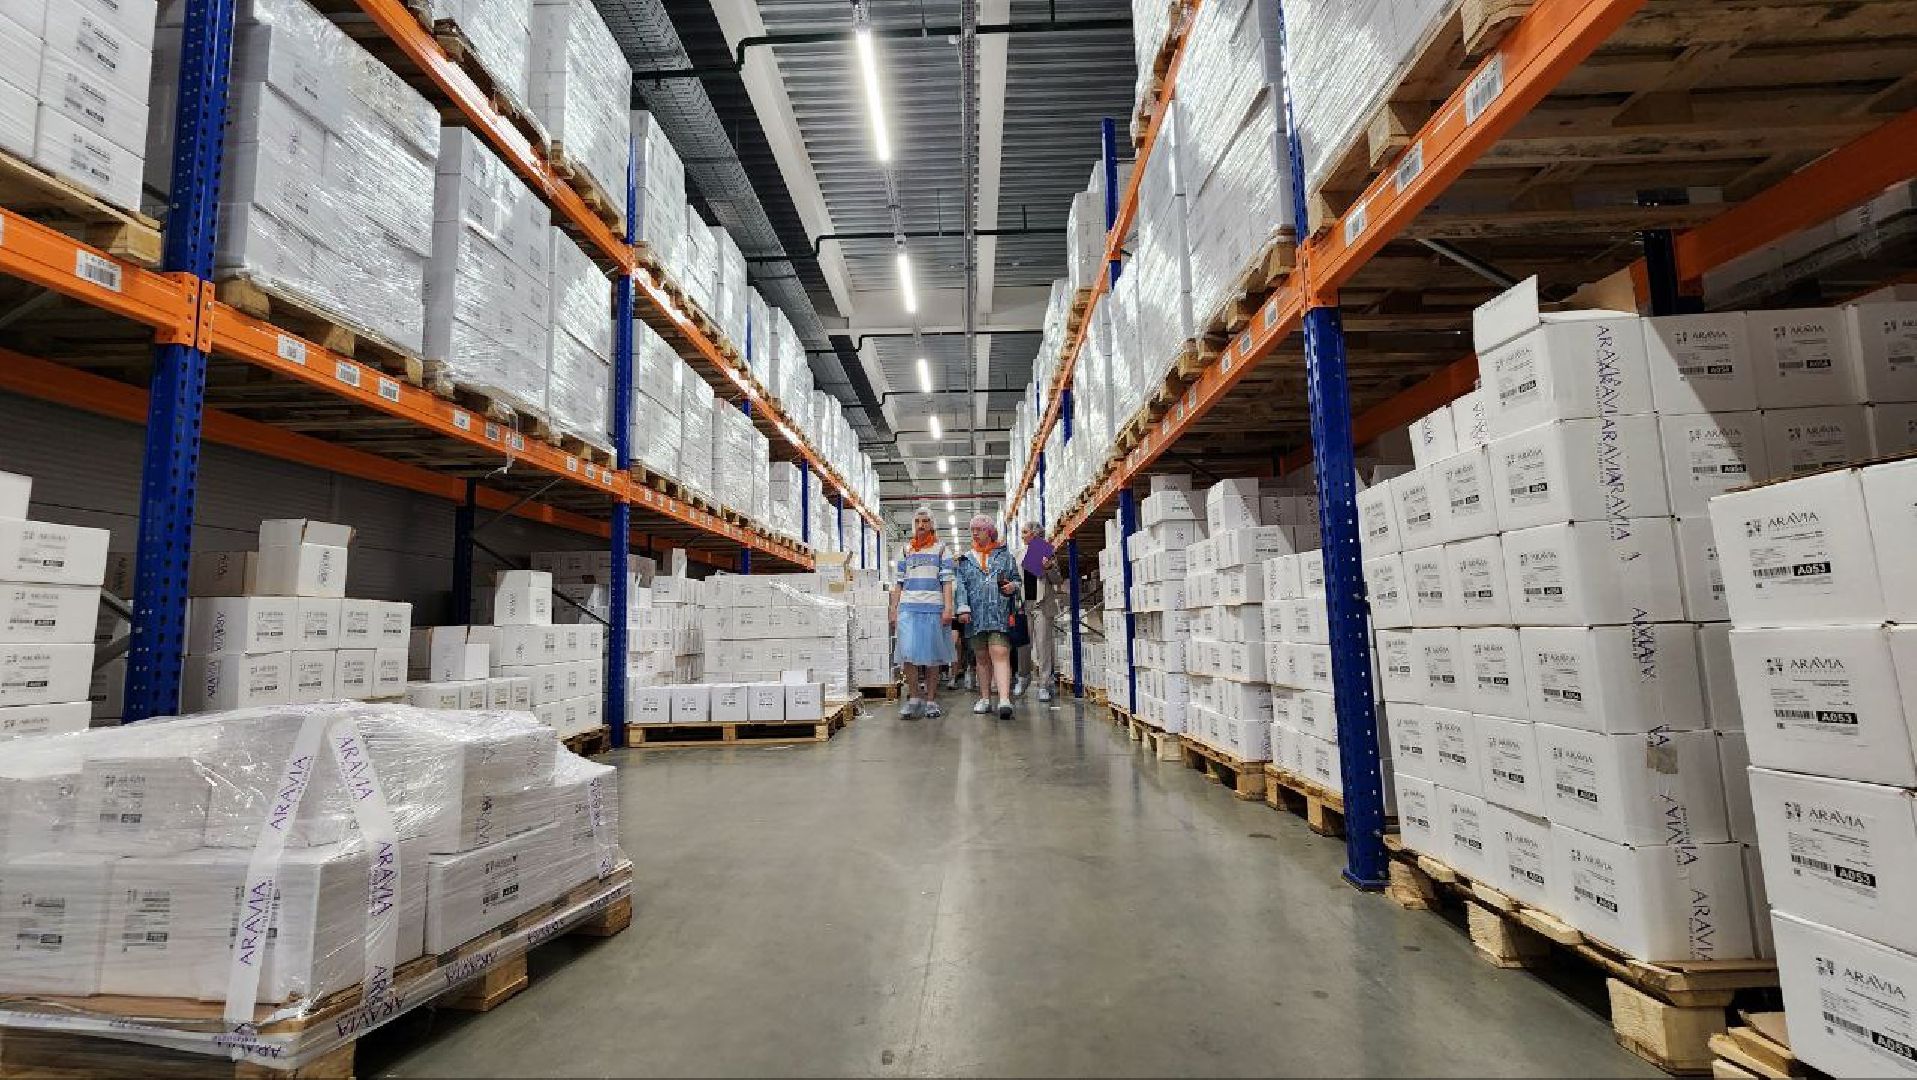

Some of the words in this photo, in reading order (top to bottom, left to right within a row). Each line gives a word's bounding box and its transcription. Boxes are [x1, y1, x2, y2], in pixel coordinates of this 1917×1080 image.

[1768, 512, 1819, 528] ARAVIA
[1796, 562, 1828, 576] A053
[1791, 656, 1844, 669] ARAVIA
[1821, 711, 1854, 724] A053
[336, 737, 375, 800] ARAVIA
[270, 756, 308, 829] ARAVIA
[1809, 808, 1865, 829] ARAVIA
[372, 841, 397, 917] ARAVIA
[240, 881, 267, 965] ARAVIA
[1691, 889, 1716, 961] ARAVIA
[1844, 969, 1906, 999] ARAVIA
[335, 994, 406, 1039] ARAVIA
